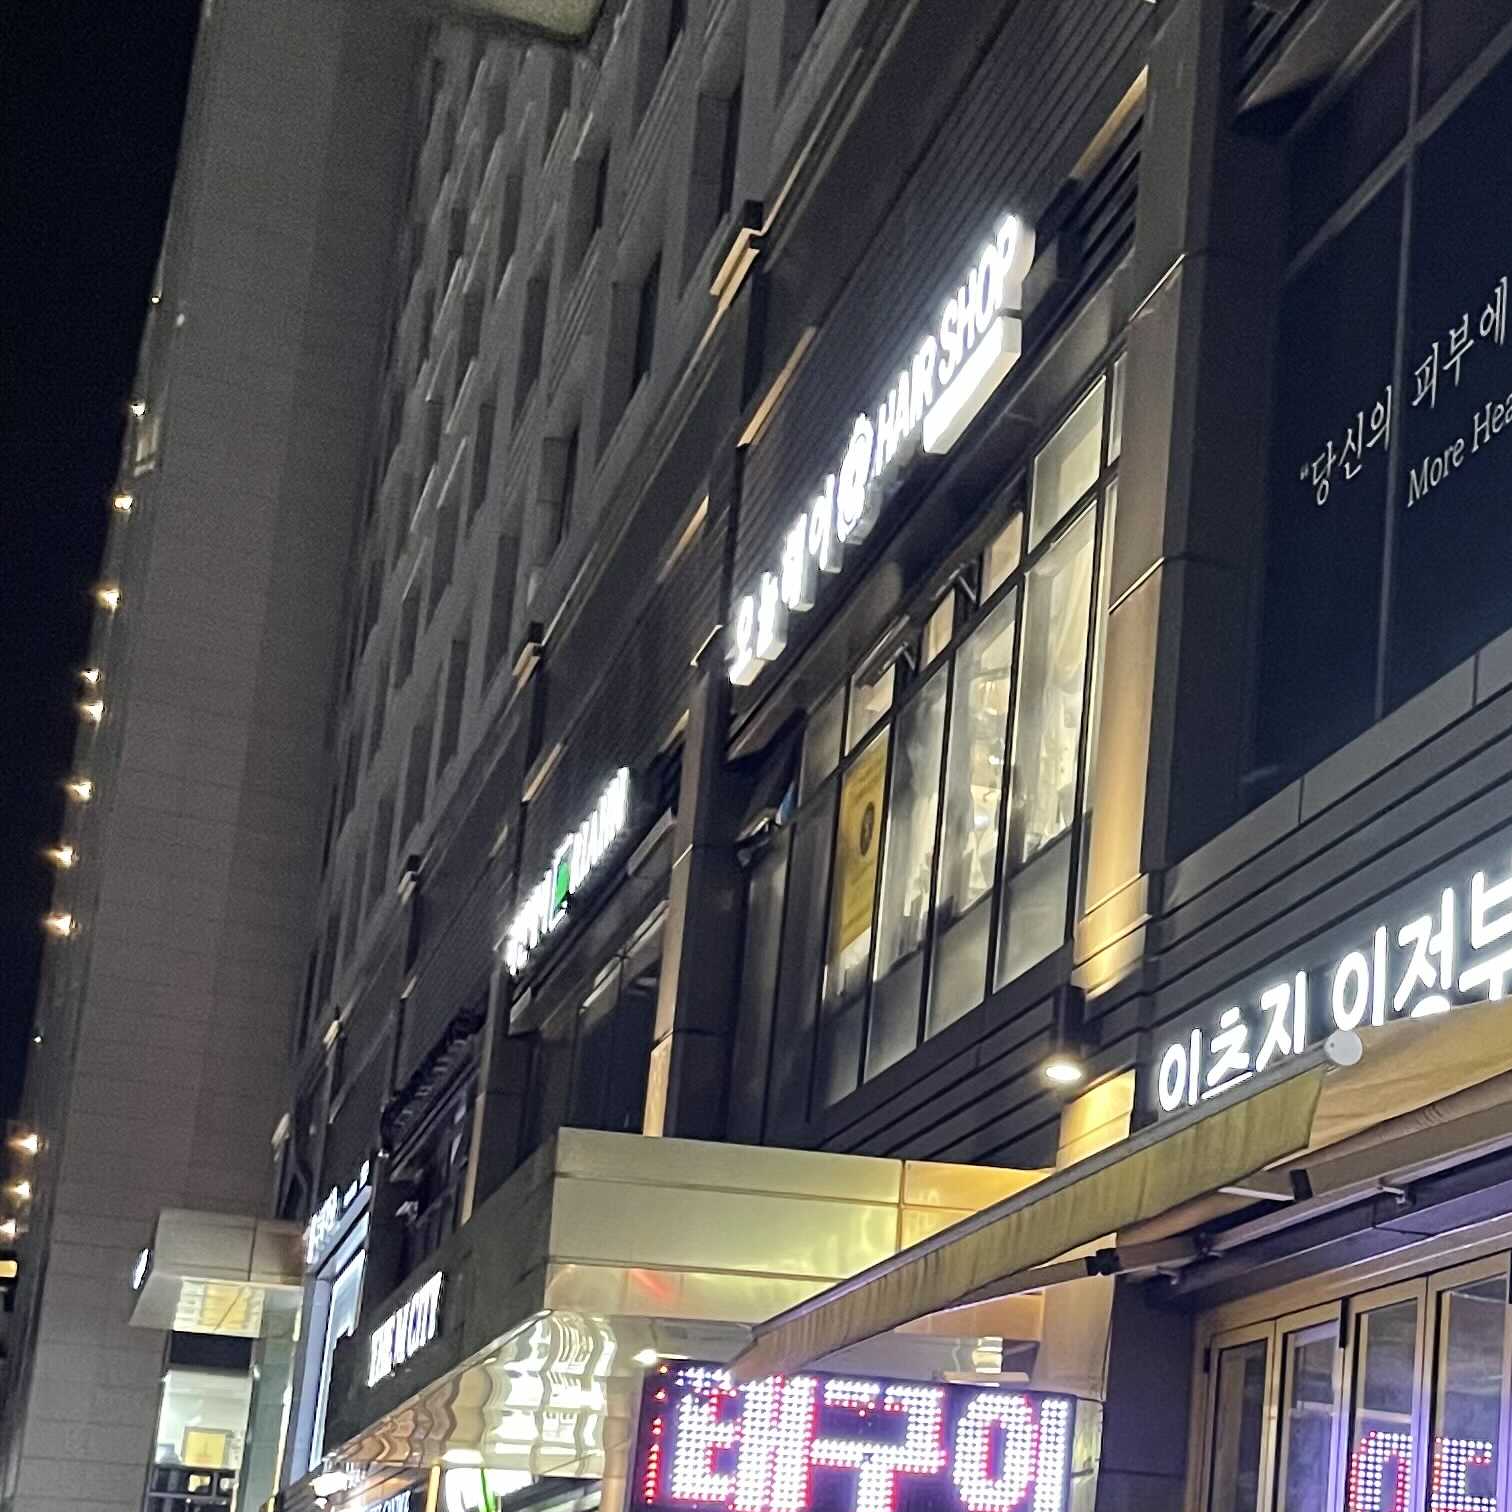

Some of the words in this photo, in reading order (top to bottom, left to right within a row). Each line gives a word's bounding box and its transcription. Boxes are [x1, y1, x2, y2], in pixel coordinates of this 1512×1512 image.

[873, 334, 939, 478] HAIR
[938, 214, 1020, 386] SHOP
[1411, 276, 1508, 408] 피부에
[1407, 440, 1465, 507] More
